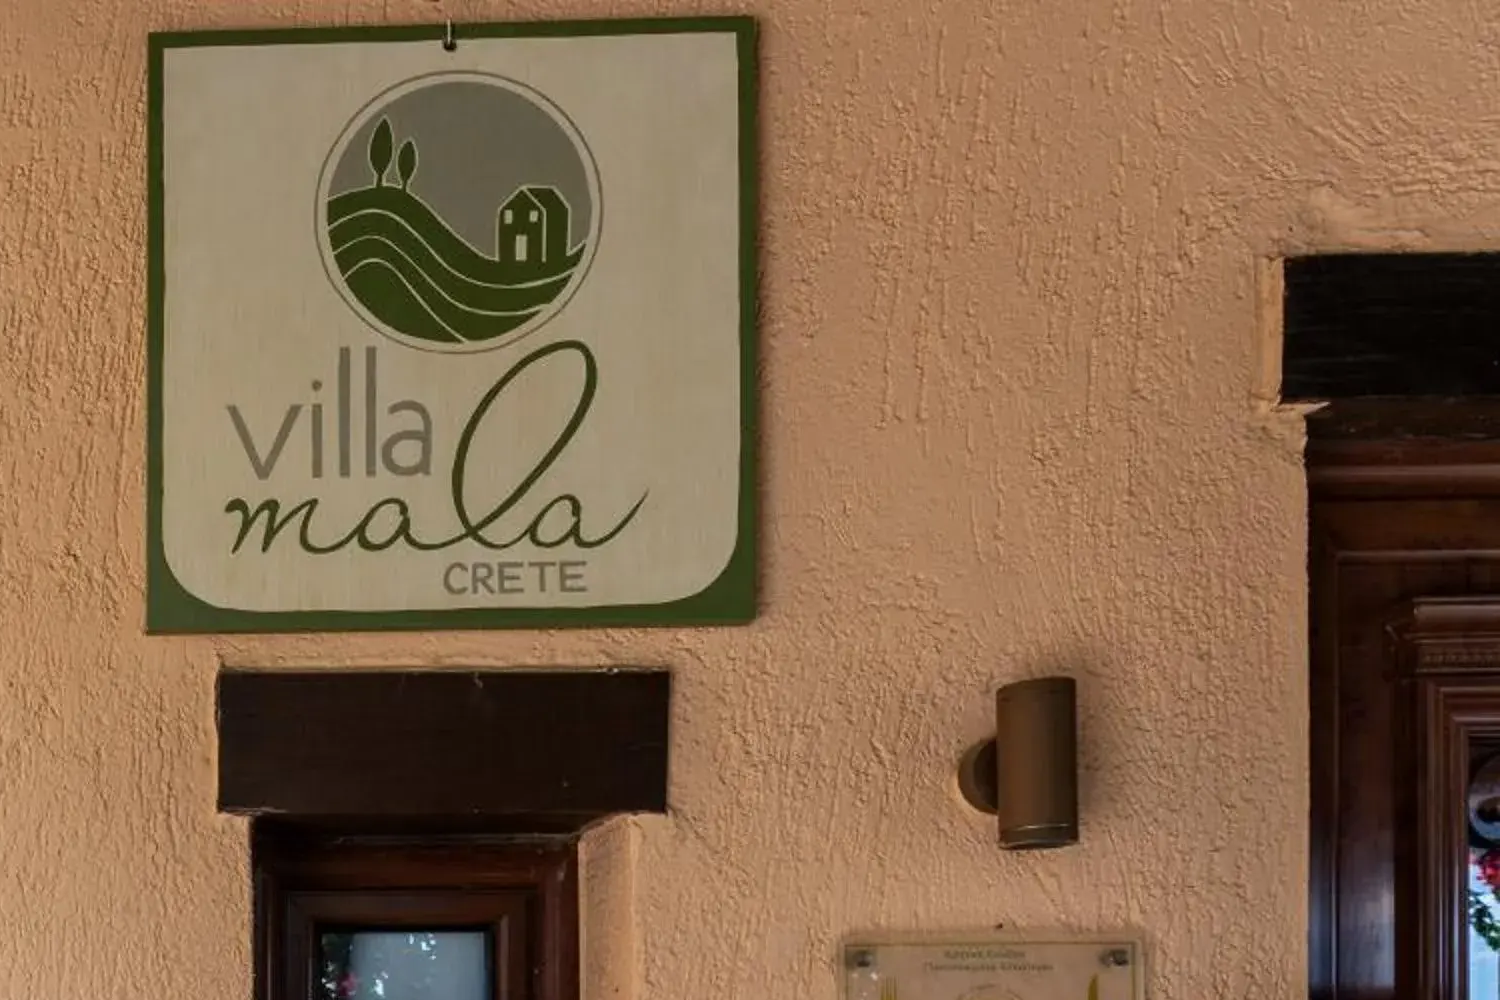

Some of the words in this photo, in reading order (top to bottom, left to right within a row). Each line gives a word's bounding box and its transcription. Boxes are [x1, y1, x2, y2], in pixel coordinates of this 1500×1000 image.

[224, 340, 649, 555] mala
[225, 345, 433, 481] villa
[443, 561, 588, 595] CRETE
